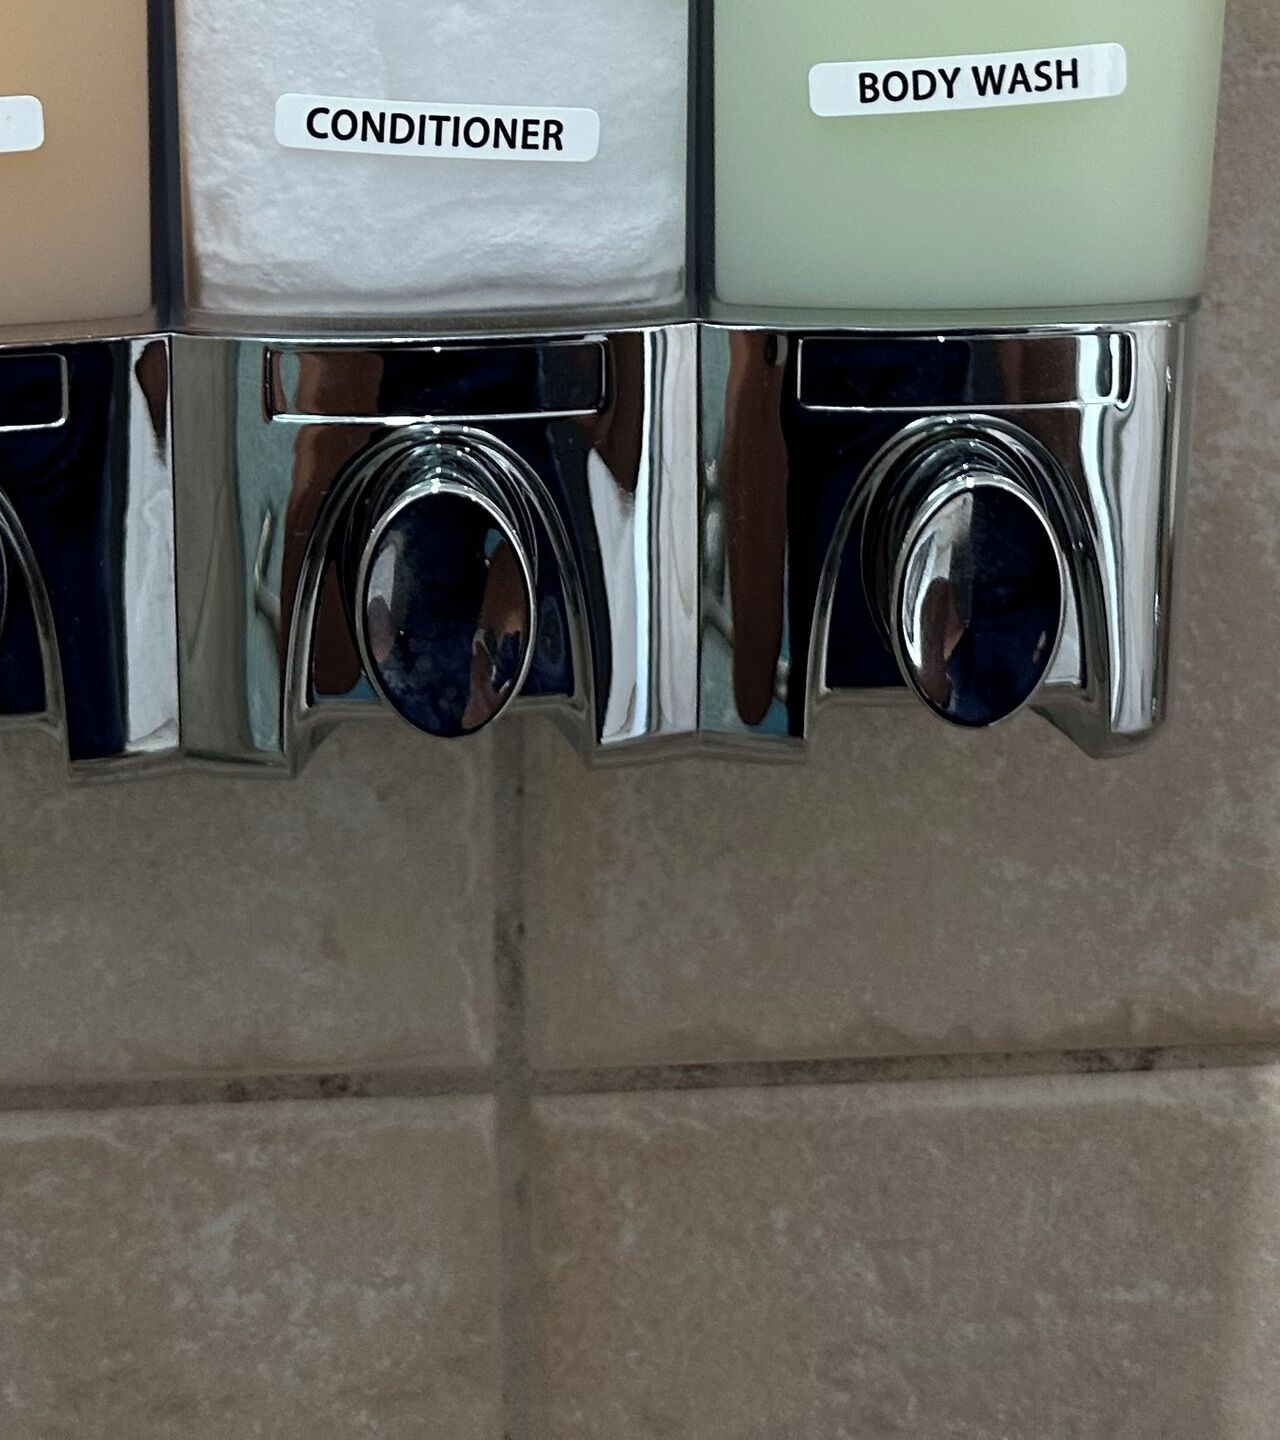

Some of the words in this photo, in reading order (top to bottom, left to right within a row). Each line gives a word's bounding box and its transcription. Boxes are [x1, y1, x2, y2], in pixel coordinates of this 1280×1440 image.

[858, 66, 961, 104] BODY
[971, 57, 1079, 97] WASH
[306, 107, 564, 152] CONDITIONER
